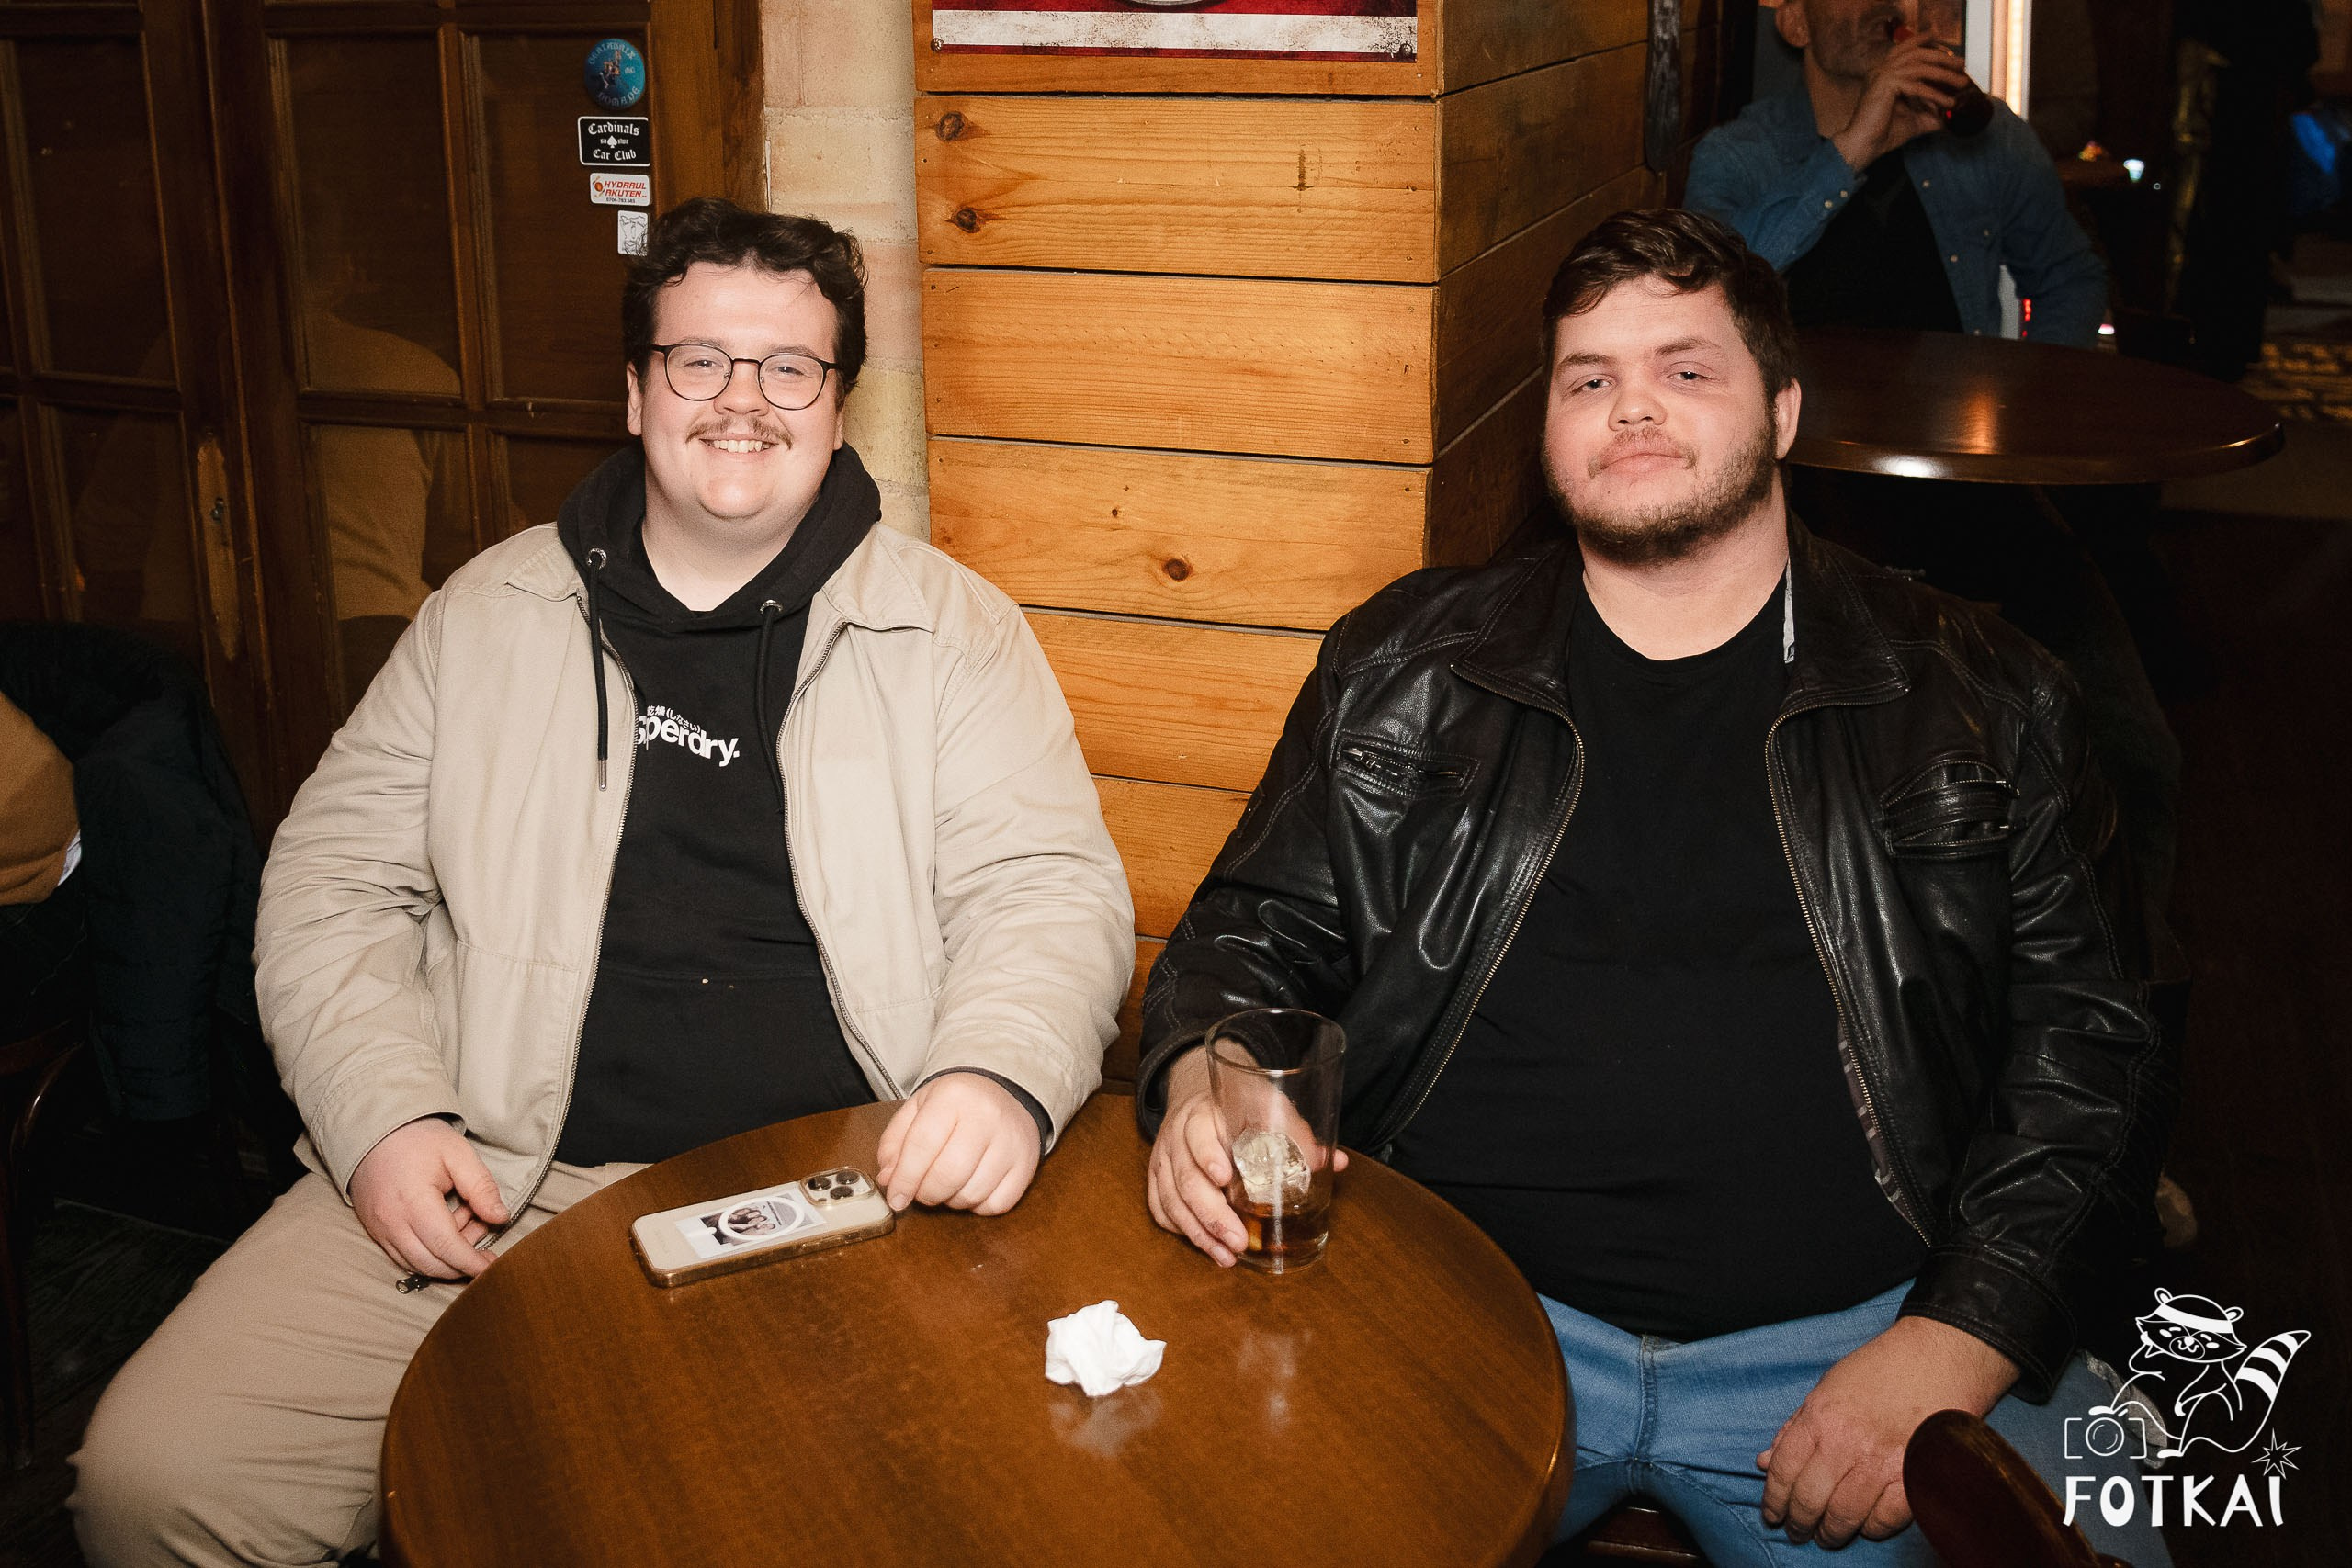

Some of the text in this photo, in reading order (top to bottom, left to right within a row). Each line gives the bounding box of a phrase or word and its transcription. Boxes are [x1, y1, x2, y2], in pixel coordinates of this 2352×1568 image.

[588, 120, 640, 136] Cardinals
[593, 148, 637, 161] Car Club
[604, 180, 647, 190] HYDRAUL
[605, 188, 642, 198] AKUTEN
